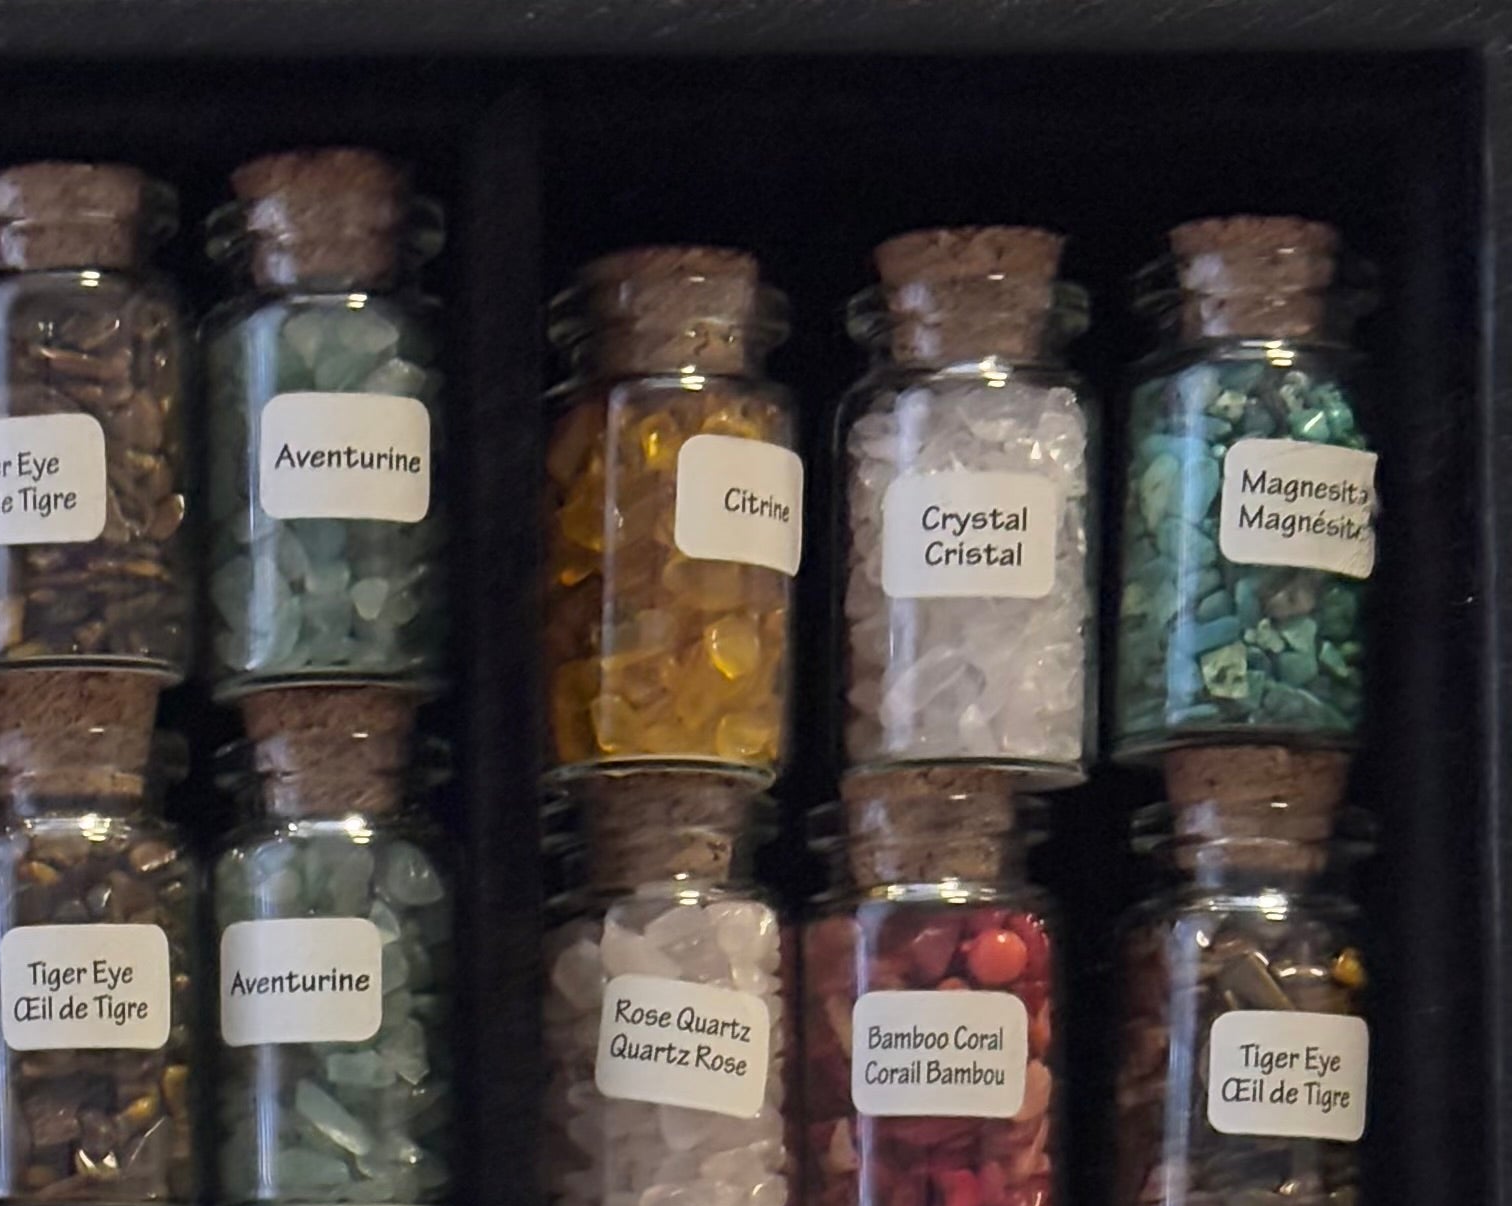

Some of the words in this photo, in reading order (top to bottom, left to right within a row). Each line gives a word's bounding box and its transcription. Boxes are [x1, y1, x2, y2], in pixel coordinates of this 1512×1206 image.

[17, 454, 60, 482] Eye
[275, 444, 422, 474] Aventurine
[21, 488, 77, 518] Tigre
[724, 487, 790, 522] Citrine
[921, 506, 1028, 538] Crystal
[924, 541, 1022, 567] Cristal
[28, 961, 88, 993] Tiger
[92, 960, 134, 991] Eye
[230, 969, 371, 997] Aventurine
[14, 997, 54, 1022] Œil
[59, 996, 88, 1021] de
[94, 995, 149, 1026] Tigre
[614, 999, 671, 1029] Rose
[676, 1007, 751, 1043] Quartz
[867, 1026, 949, 1050] Bamboo
[953, 1027, 1004, 1052] Coral
[609, 1034, 690, 1067] Quartz
[695, 1046, 747, 1077] Rose
[1240, 1044, 1300, 1076] Tiger
[1305, 1048, 1341, 1075] Eye
[864, 1061, 922, 1085] Corail
[926, 1061, 1005, 1087] Bambou
[1221, 1077, 1264, 1102] Œil
[1269, 1079, 1299, 1103] de
[1304, 1081, 1351, 1112] Tigre
